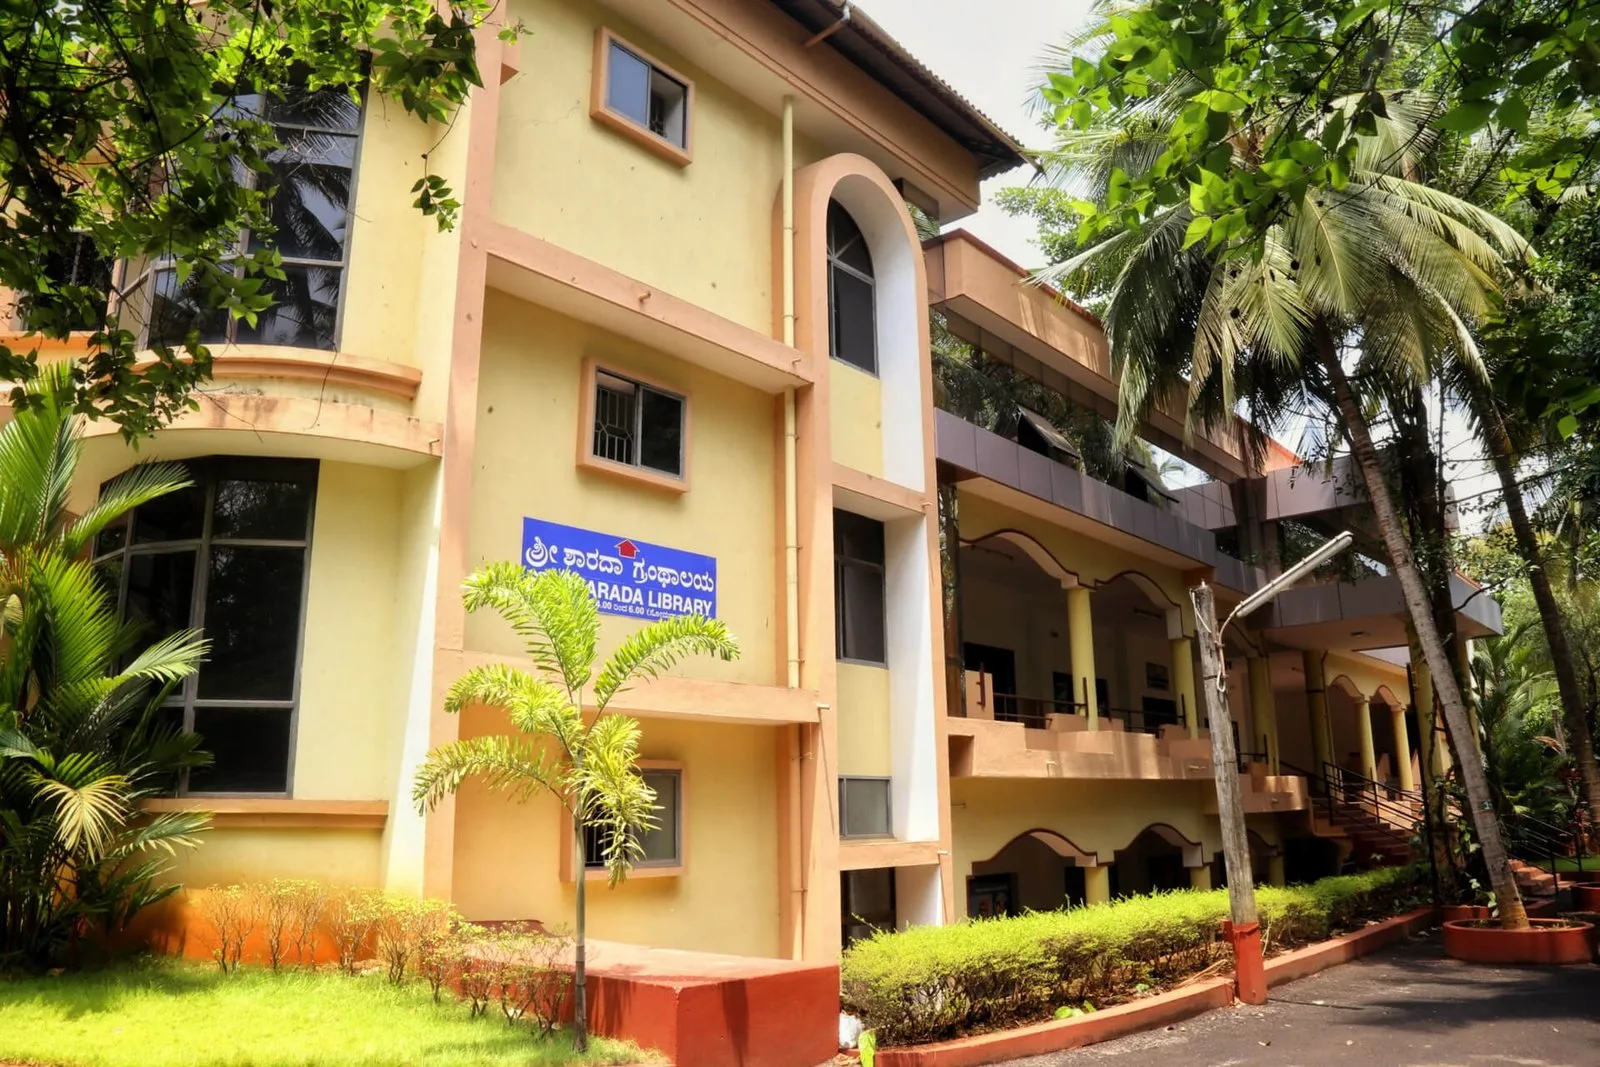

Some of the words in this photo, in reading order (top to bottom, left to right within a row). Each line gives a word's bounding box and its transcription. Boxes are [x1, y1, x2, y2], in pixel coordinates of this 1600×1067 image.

[525, 536, 558, 567] ಶ್ರೀ
[563, 547, 624, 575] ಶಾರದಾ
[632, 558, 714, 592] ಗ್ರಂಥಾಲಯ
[587, 580, 644, 605] ARADA
[648, 590, 712, 616] LIBRARY
[628, 605, 645, 615] 6.00
